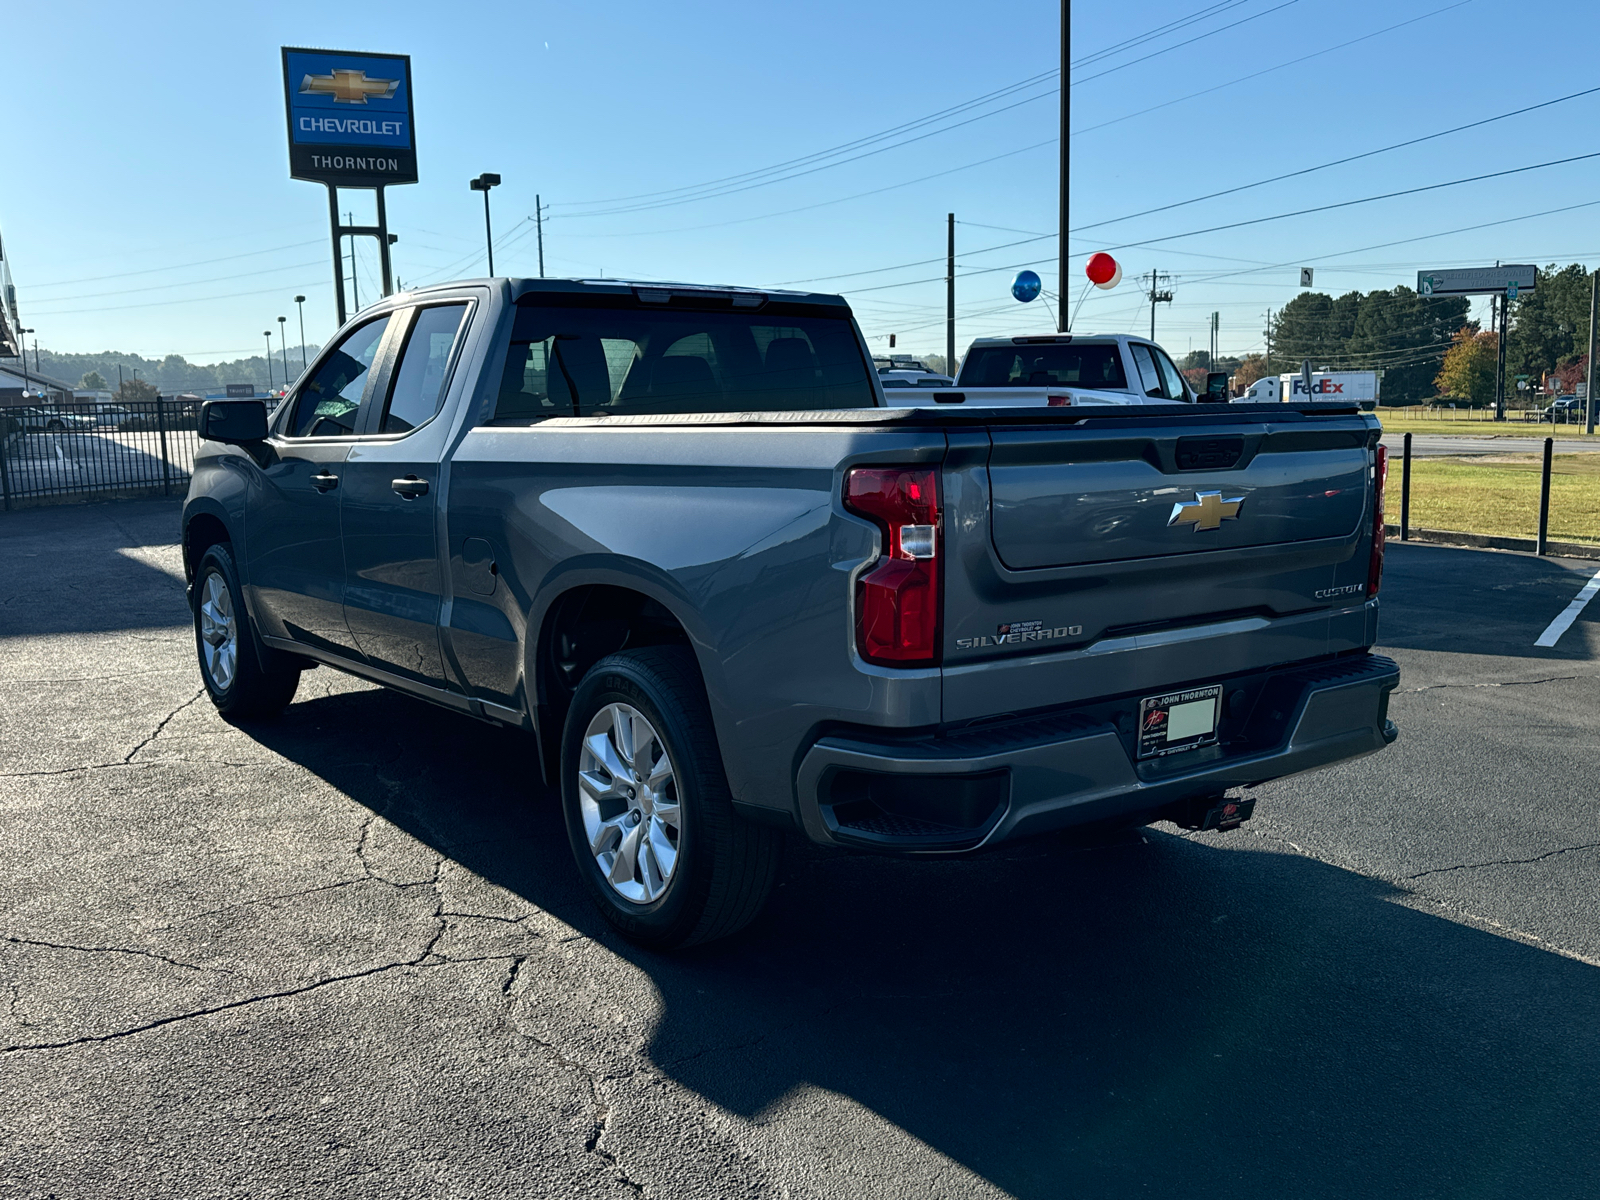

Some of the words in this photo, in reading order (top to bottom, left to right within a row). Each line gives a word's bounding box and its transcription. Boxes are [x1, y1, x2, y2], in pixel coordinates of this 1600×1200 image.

[300, 117, 403, 136] CHEVROLET
[311, 155, 399, 171] THORNTON
[1445, 271, 1484, 280] CERTIFIED
[1485, 269, 1532, 278] PRE-OWNED
[1470, 279, 1507, 287] VEHICLES
[1293, 379, 1344, 395] FedEx
[956, 624, 1083, 650] SILVERADO
[1161, 694, 1180, 706] JOHN
[1181, 687, 1219, 701] THORNTON
[1167, 745, 1191, 755] CHEVROLET
